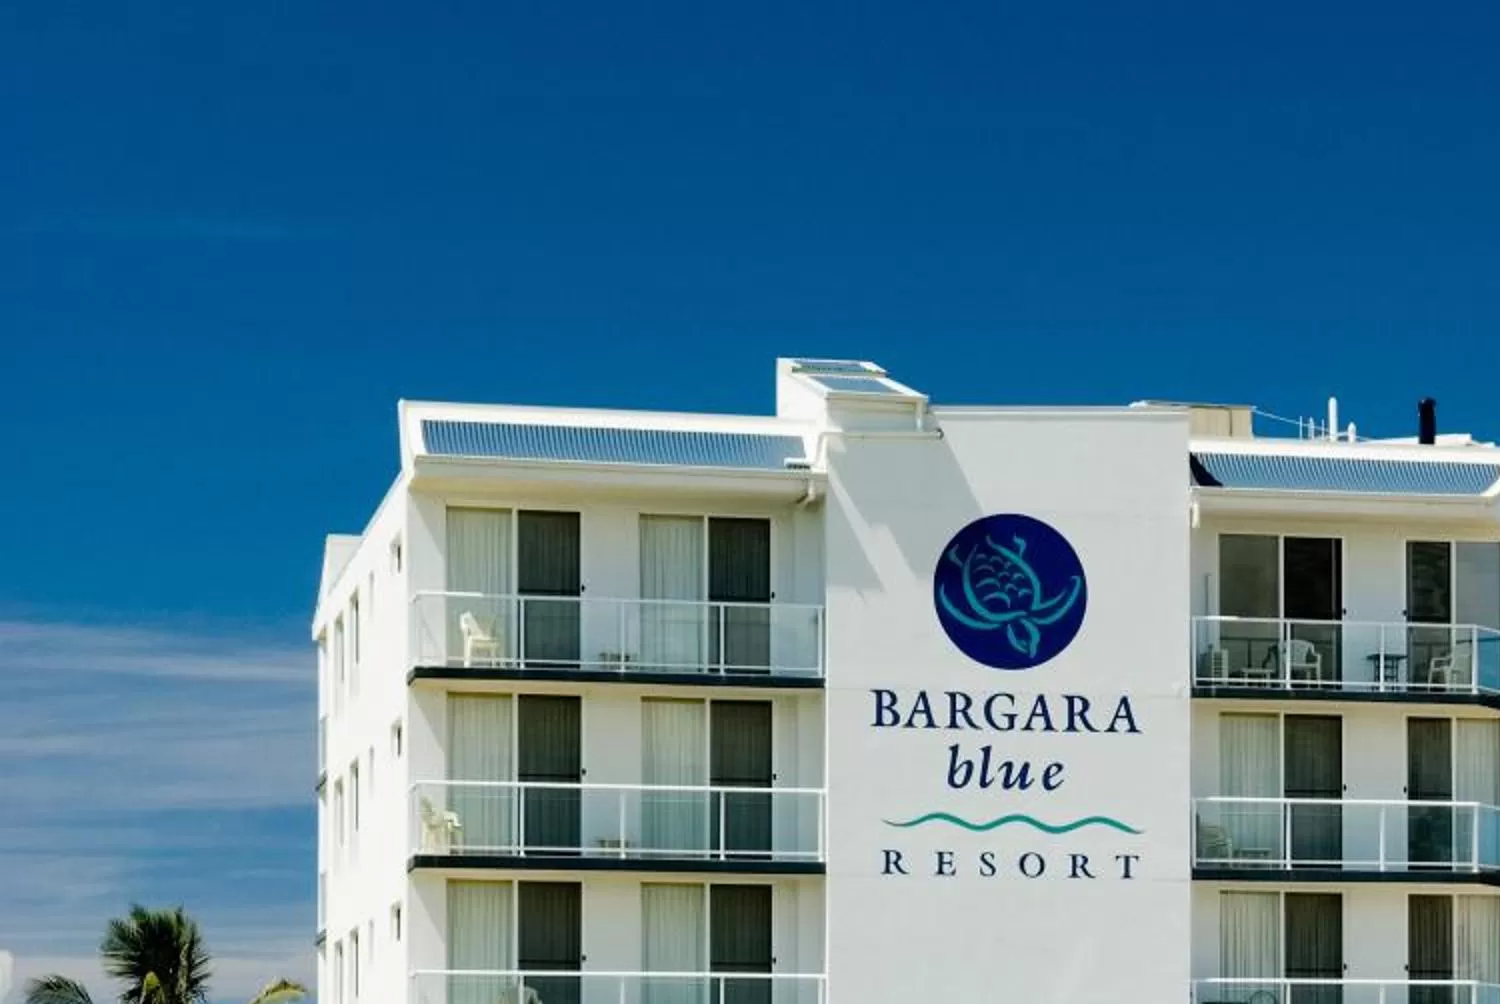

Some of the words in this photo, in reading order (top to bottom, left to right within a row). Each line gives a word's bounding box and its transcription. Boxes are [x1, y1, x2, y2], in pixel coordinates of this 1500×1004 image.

[870, 688, 1143, 734] BARGARA
[946, 744, 1065, 791] blue
[881, 849, 1140, 879] RESORT
